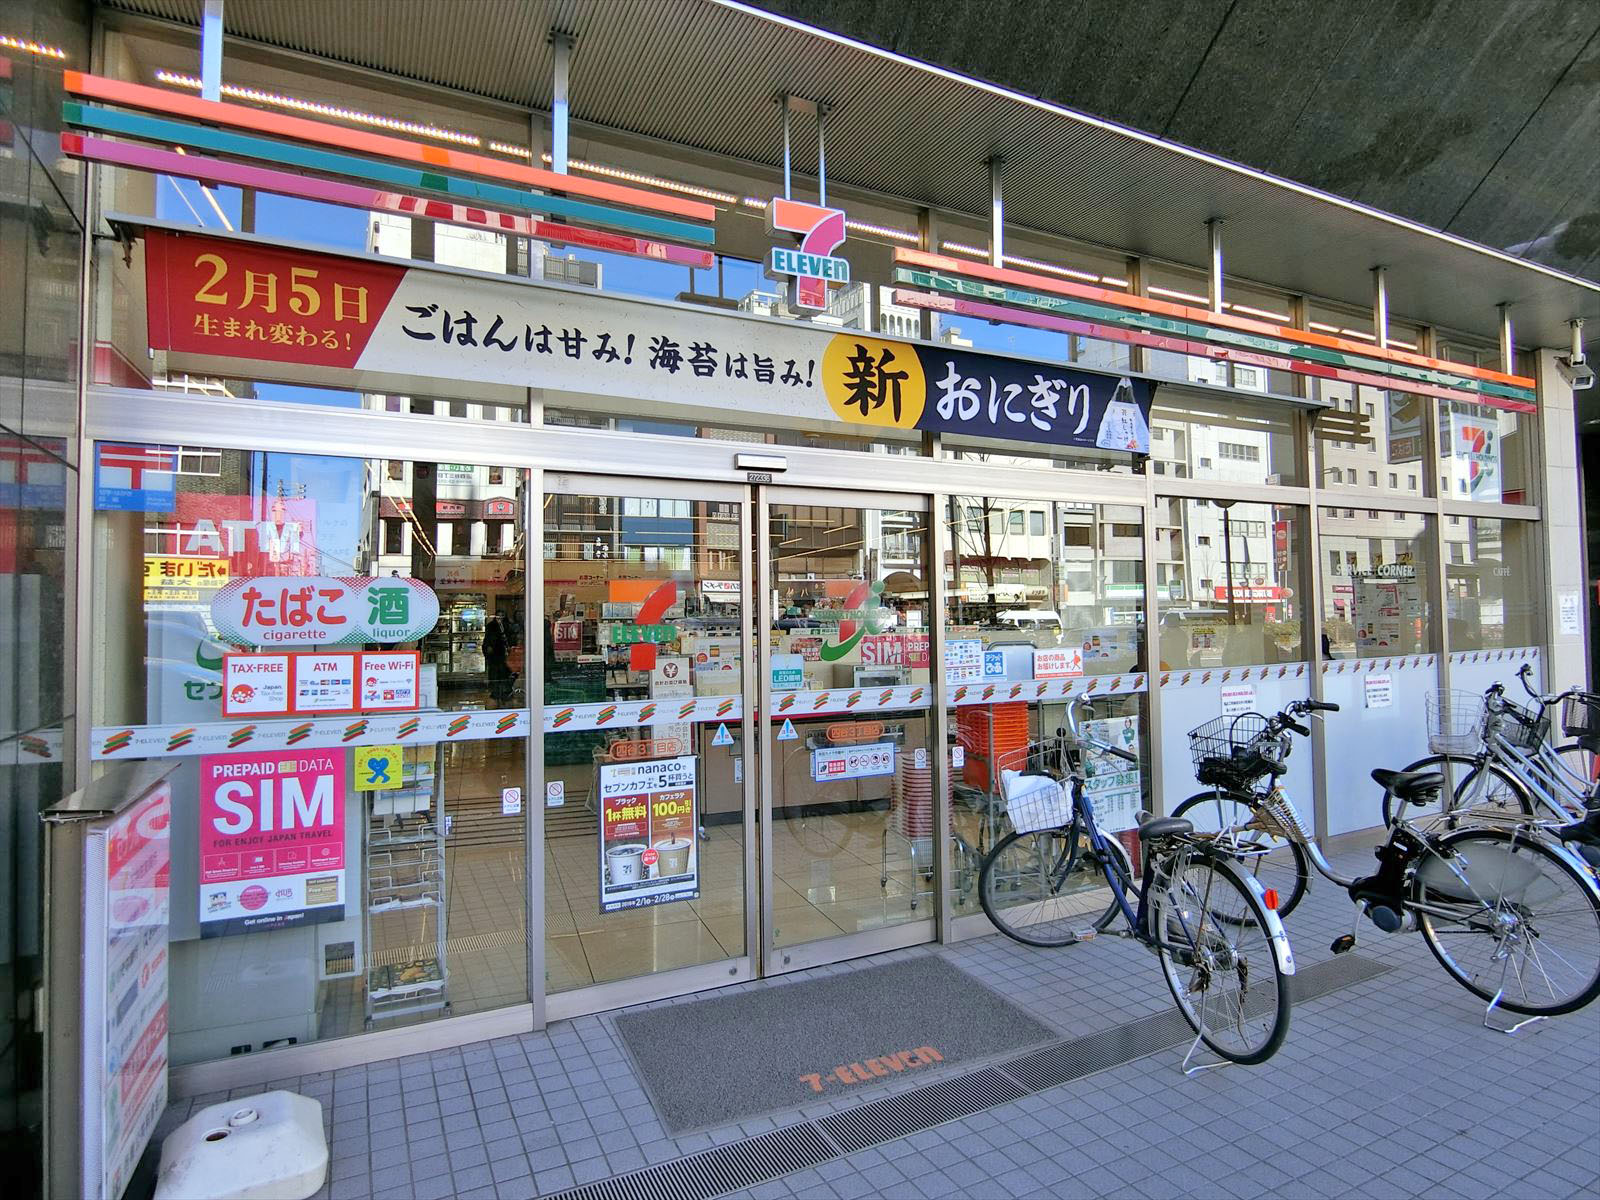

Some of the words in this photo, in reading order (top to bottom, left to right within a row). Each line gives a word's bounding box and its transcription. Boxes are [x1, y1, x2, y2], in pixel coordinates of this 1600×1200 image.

[193, 253, 370, 325] 2月5日
[193, 313, 352, 352] 生まれ変わる!
[401, 303, 634, 365] ごはんは甘み!
[649, 334, 815, 387] 海苔は旨み!
[842, 343, 909, 423] 新
[935, 361, 1090, 436] おにぎり
[185, 519, 301, 558] ATM
[1377, 564, 1413, 576] CORNER
[242, 586, 347, 627] たばこ
[368, 587, 409, 626] 酒
[263, 629, 326, 641] cigarette
[372, 628, 410, 639] liquor
[862, 641, 903, 664] SIM
[232, 663, 283, 673] TAX-FREE
[313, 662, 337, 672] ATM
[364, 662, 386, 671] Free
[388, 661, 414, 670] Wi-Fi
[616, 742, 677, 756] 四谷3目店
[213, 762, 275, 778] PREPAID
[300, 758, 334, 772] DATA
[213, 775, 334, 834] SIM
[615, 797, 637, 805] ブラック
[606, 805, 647, 822] 1杯無料
[213, 841, 232, 849] FOR
[268, 834, 297, 843] JAPAN
[300, 830, 332, 838] TRAVEL
